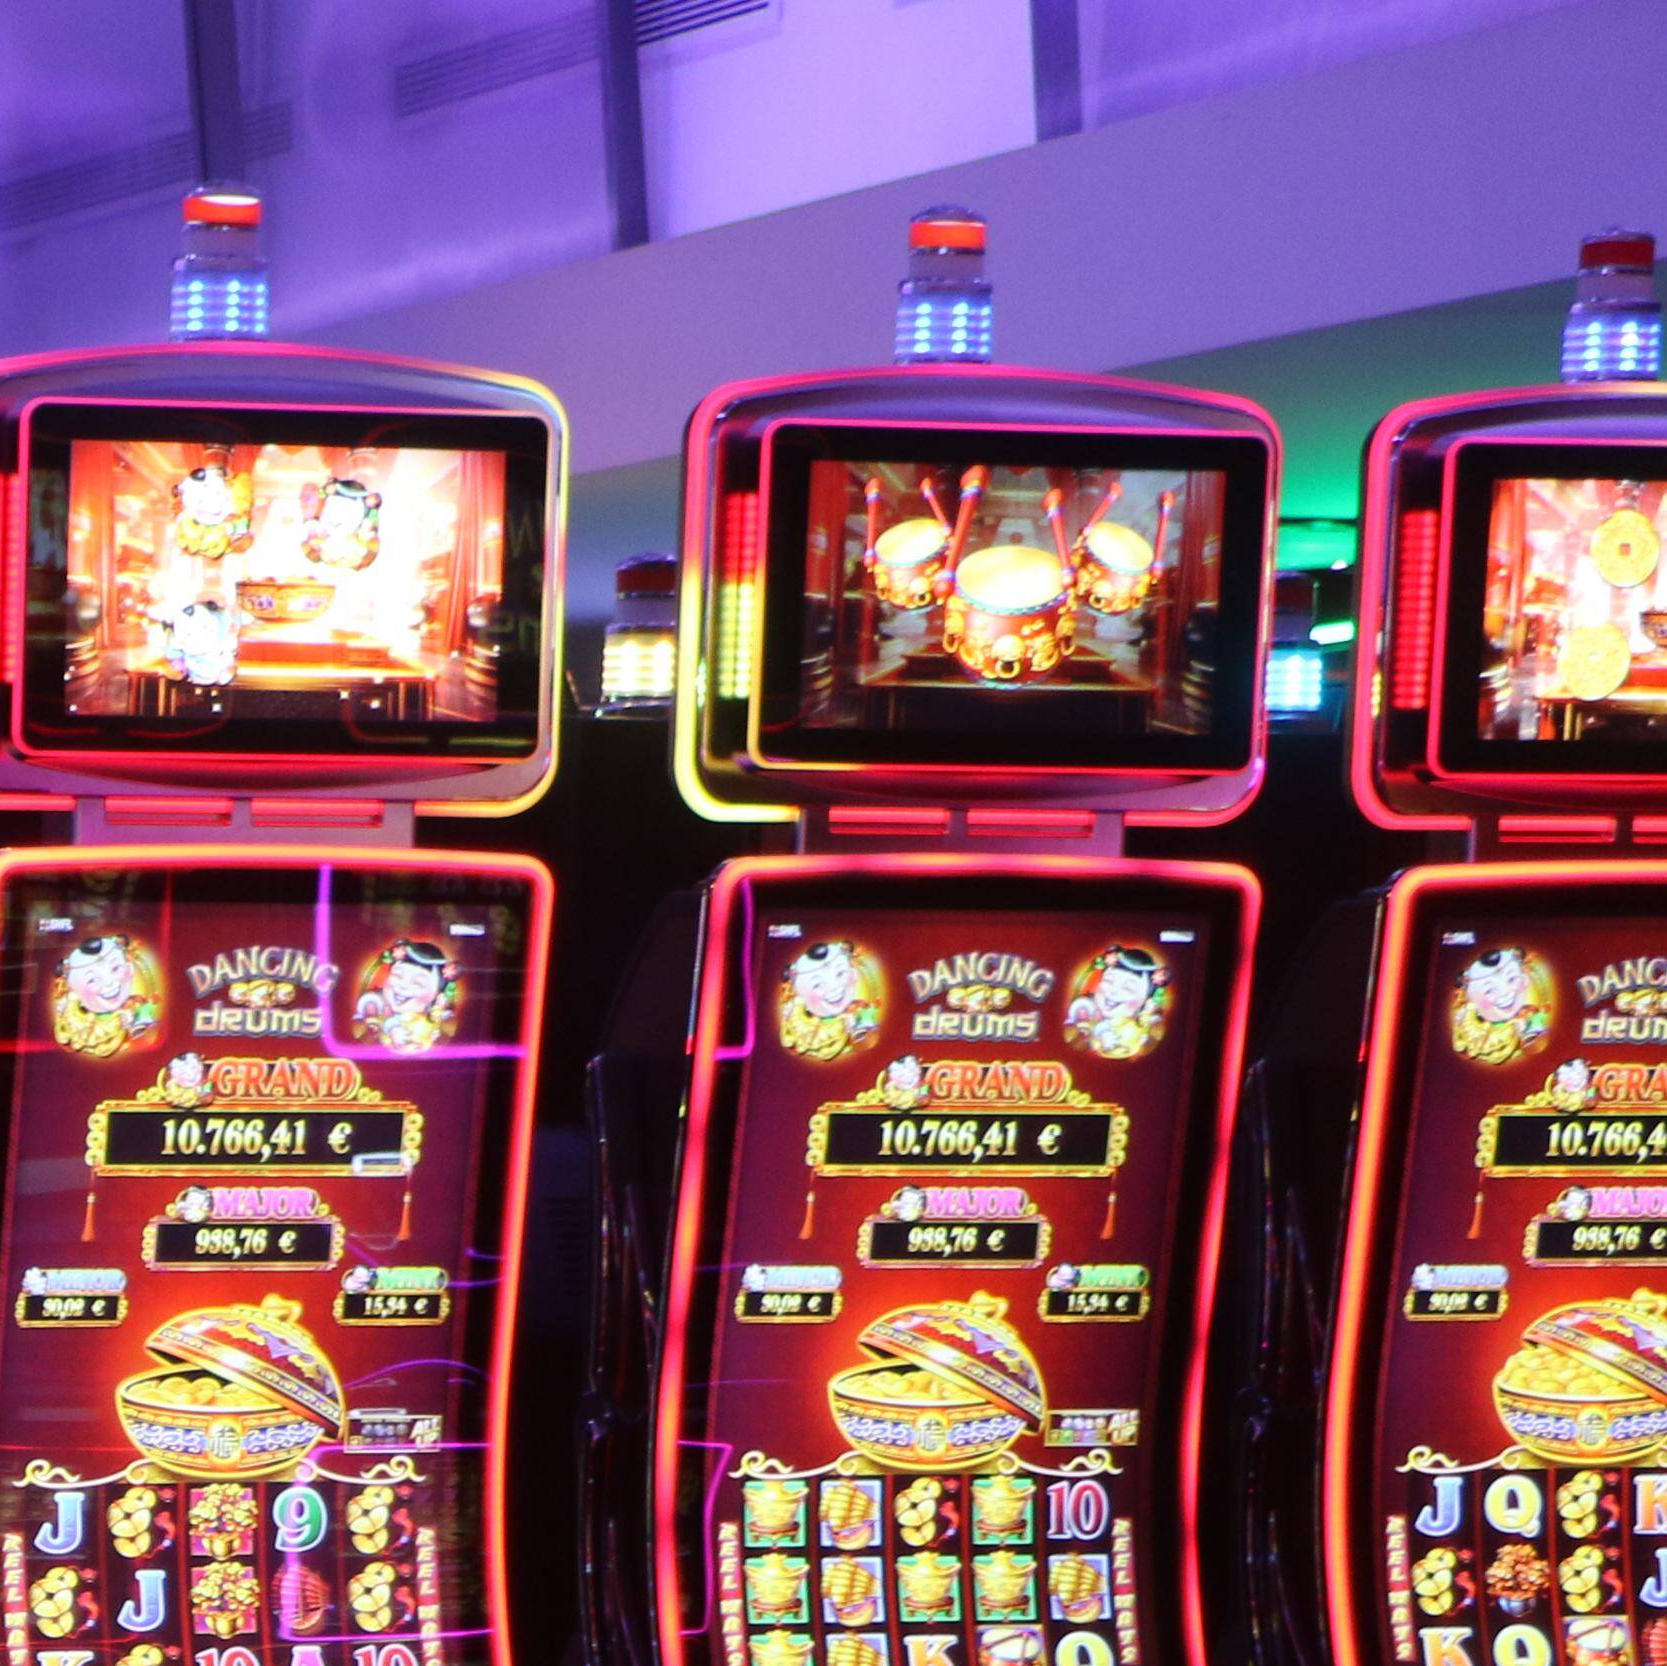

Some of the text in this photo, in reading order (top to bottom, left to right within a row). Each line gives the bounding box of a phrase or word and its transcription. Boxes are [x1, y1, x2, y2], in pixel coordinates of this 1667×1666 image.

[186, 945, 342, 997] DANCING
[907, 951, 1056, 1003] DANCING
[1577, 956, 1667, 1008] DANC
[209, 1058, 357, 1100] GRAND
[925, 1060, 1067, 1101] GRAND
[159, 1118, 353, 1163] 10.766,41 €
[877, 1120, 1062, 1164] 10.766,41 €
[1545, 1120, 1667, 1164] 10.766,4
[211, 1188, 316, 1219] MAJOR
[924, 1188, 1026, 1218] MAJOR
[1589, 1187, 1667, 1219] MAJO
[194, 1228, 268, 1260] 938,76
[34, 1490, 85, 1556] J
[272, 1484, 329, 1553] 9
[1046, 1480, 1111, 1541] 10
[1414, 1475, 1464, 1537] J
[1483, 1474, 1543, 1538] Q
[117, 1568, 167, 1633] J
